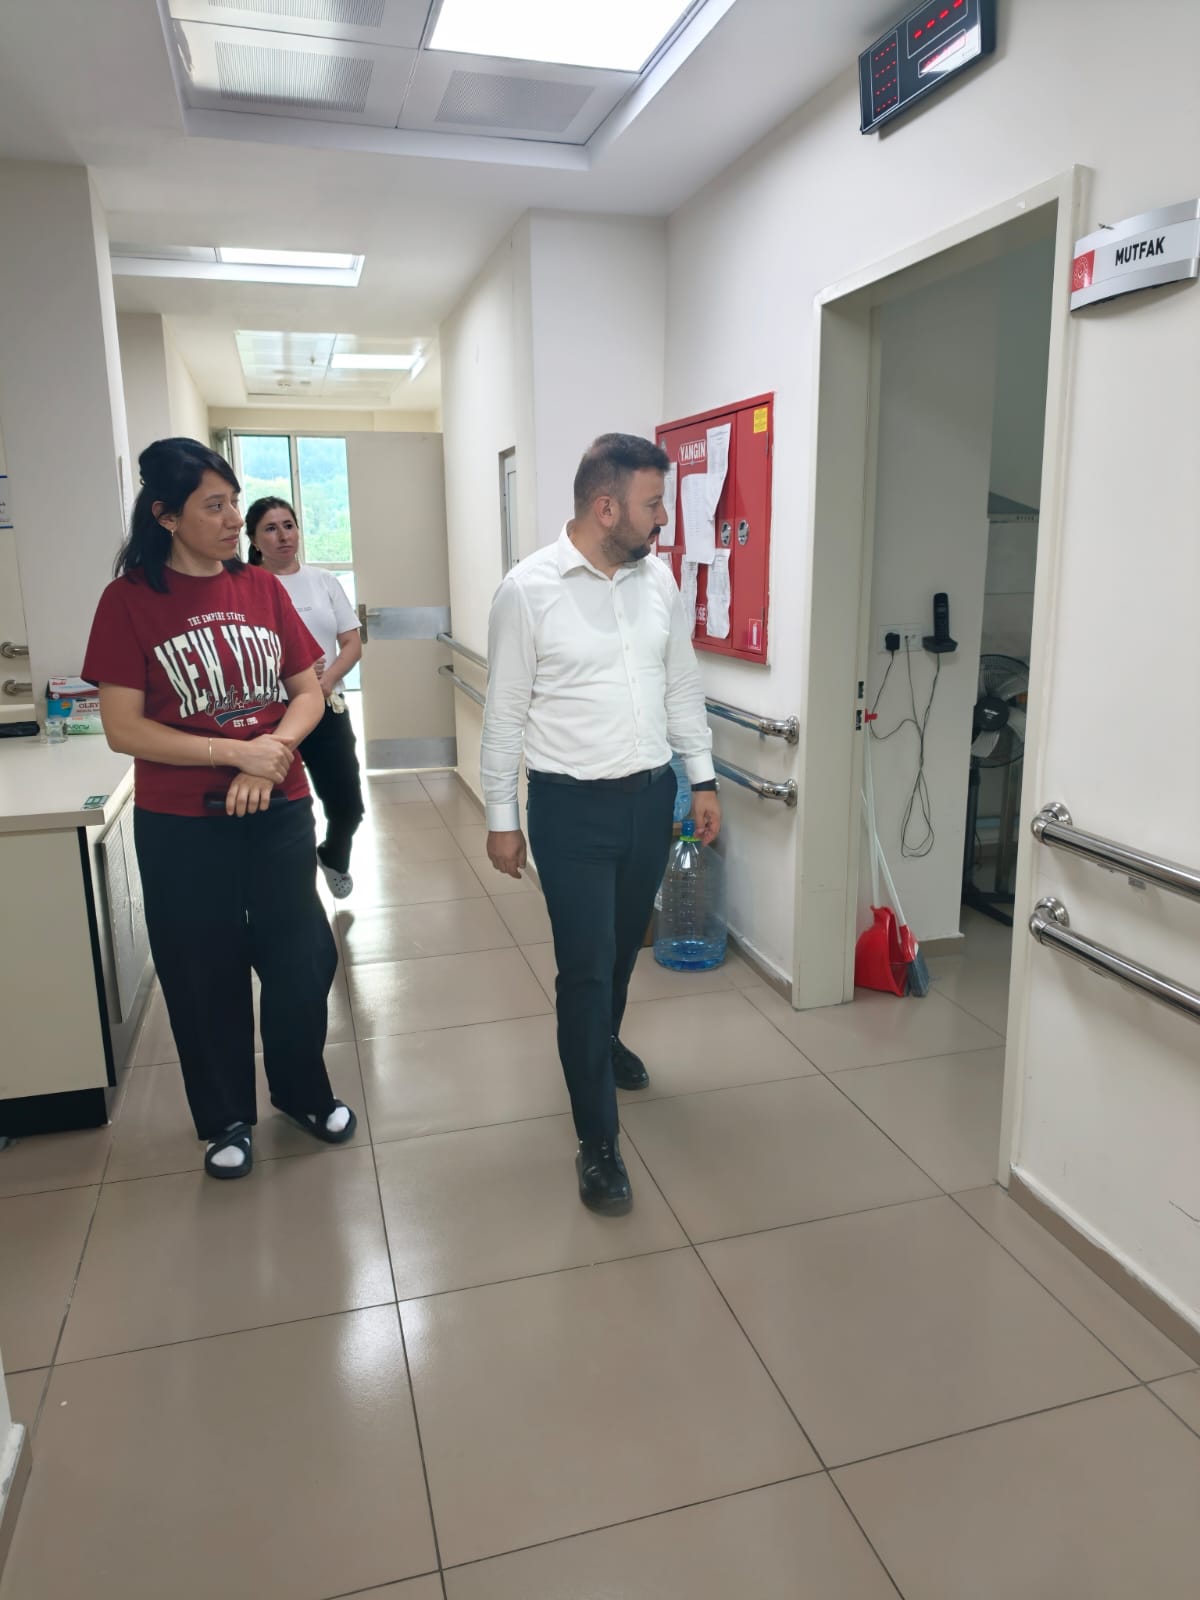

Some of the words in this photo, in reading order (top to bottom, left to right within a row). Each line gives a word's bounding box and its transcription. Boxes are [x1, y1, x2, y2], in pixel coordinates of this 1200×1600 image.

[1115, 236, 1166, 267] MUTFAK
[680, 441, 706, 462] YANGIN
[187, 615, 202, 627] THE
[201, 611, 226, 624] EMPIRE
[225, 612, 247, 623] STATE
[153, 627, 227, 719] NEW
[220, 624, 289, 703] YORK
